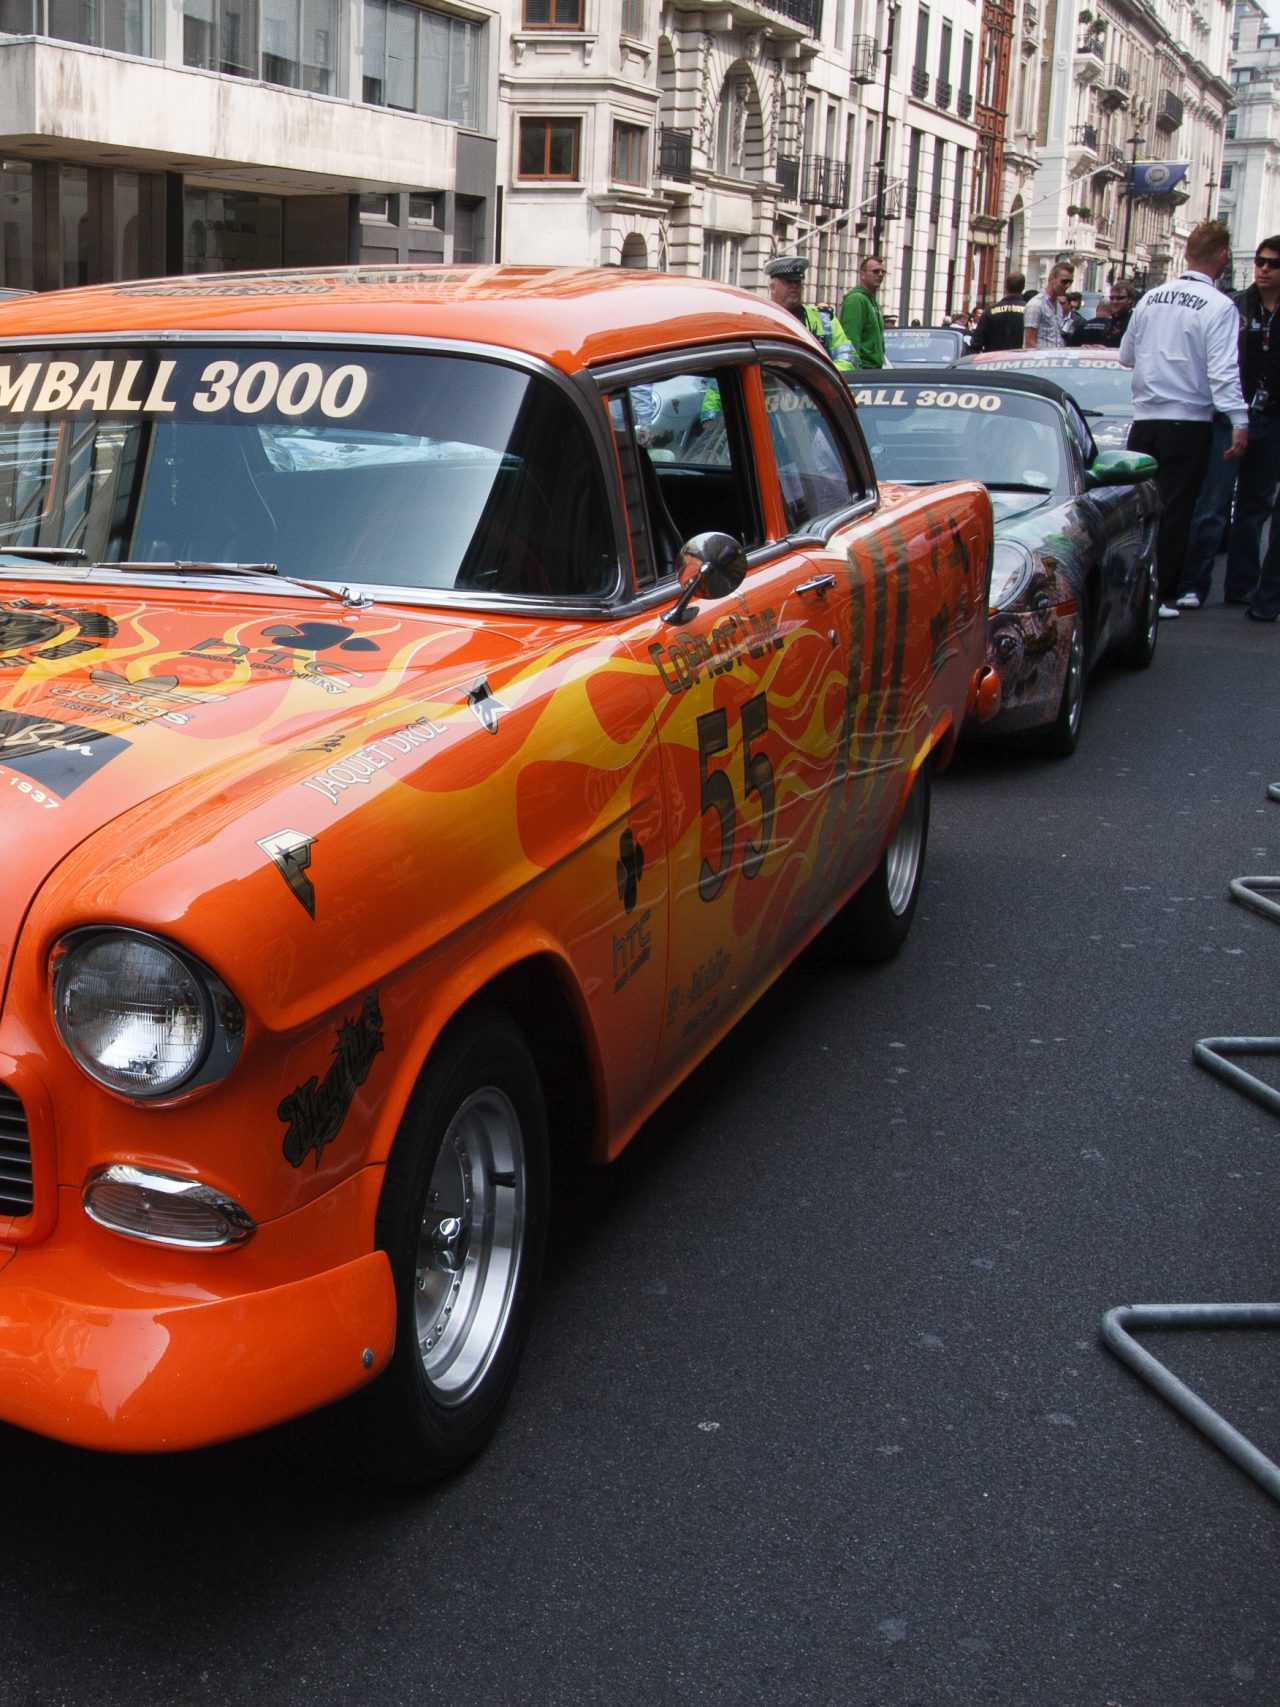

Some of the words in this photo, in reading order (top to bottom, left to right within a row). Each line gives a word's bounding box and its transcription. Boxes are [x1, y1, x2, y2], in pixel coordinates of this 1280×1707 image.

[1146, 291, 1179, 306] RALLY
[1178, 292, 1208, 311] CREW
[976, 360, 1073, 371] GUMBALL
[193, 361, 368, 418] 3000
[916, 390, 1001, 412] 3000
[50, 688, 191, 725] adidas
[302, 744, 397, 805] JAQUET
[389, 716, 449, 754] DROZ
[9, 777, 60, 810] 1937
[696, 691, 777, 903] 55
